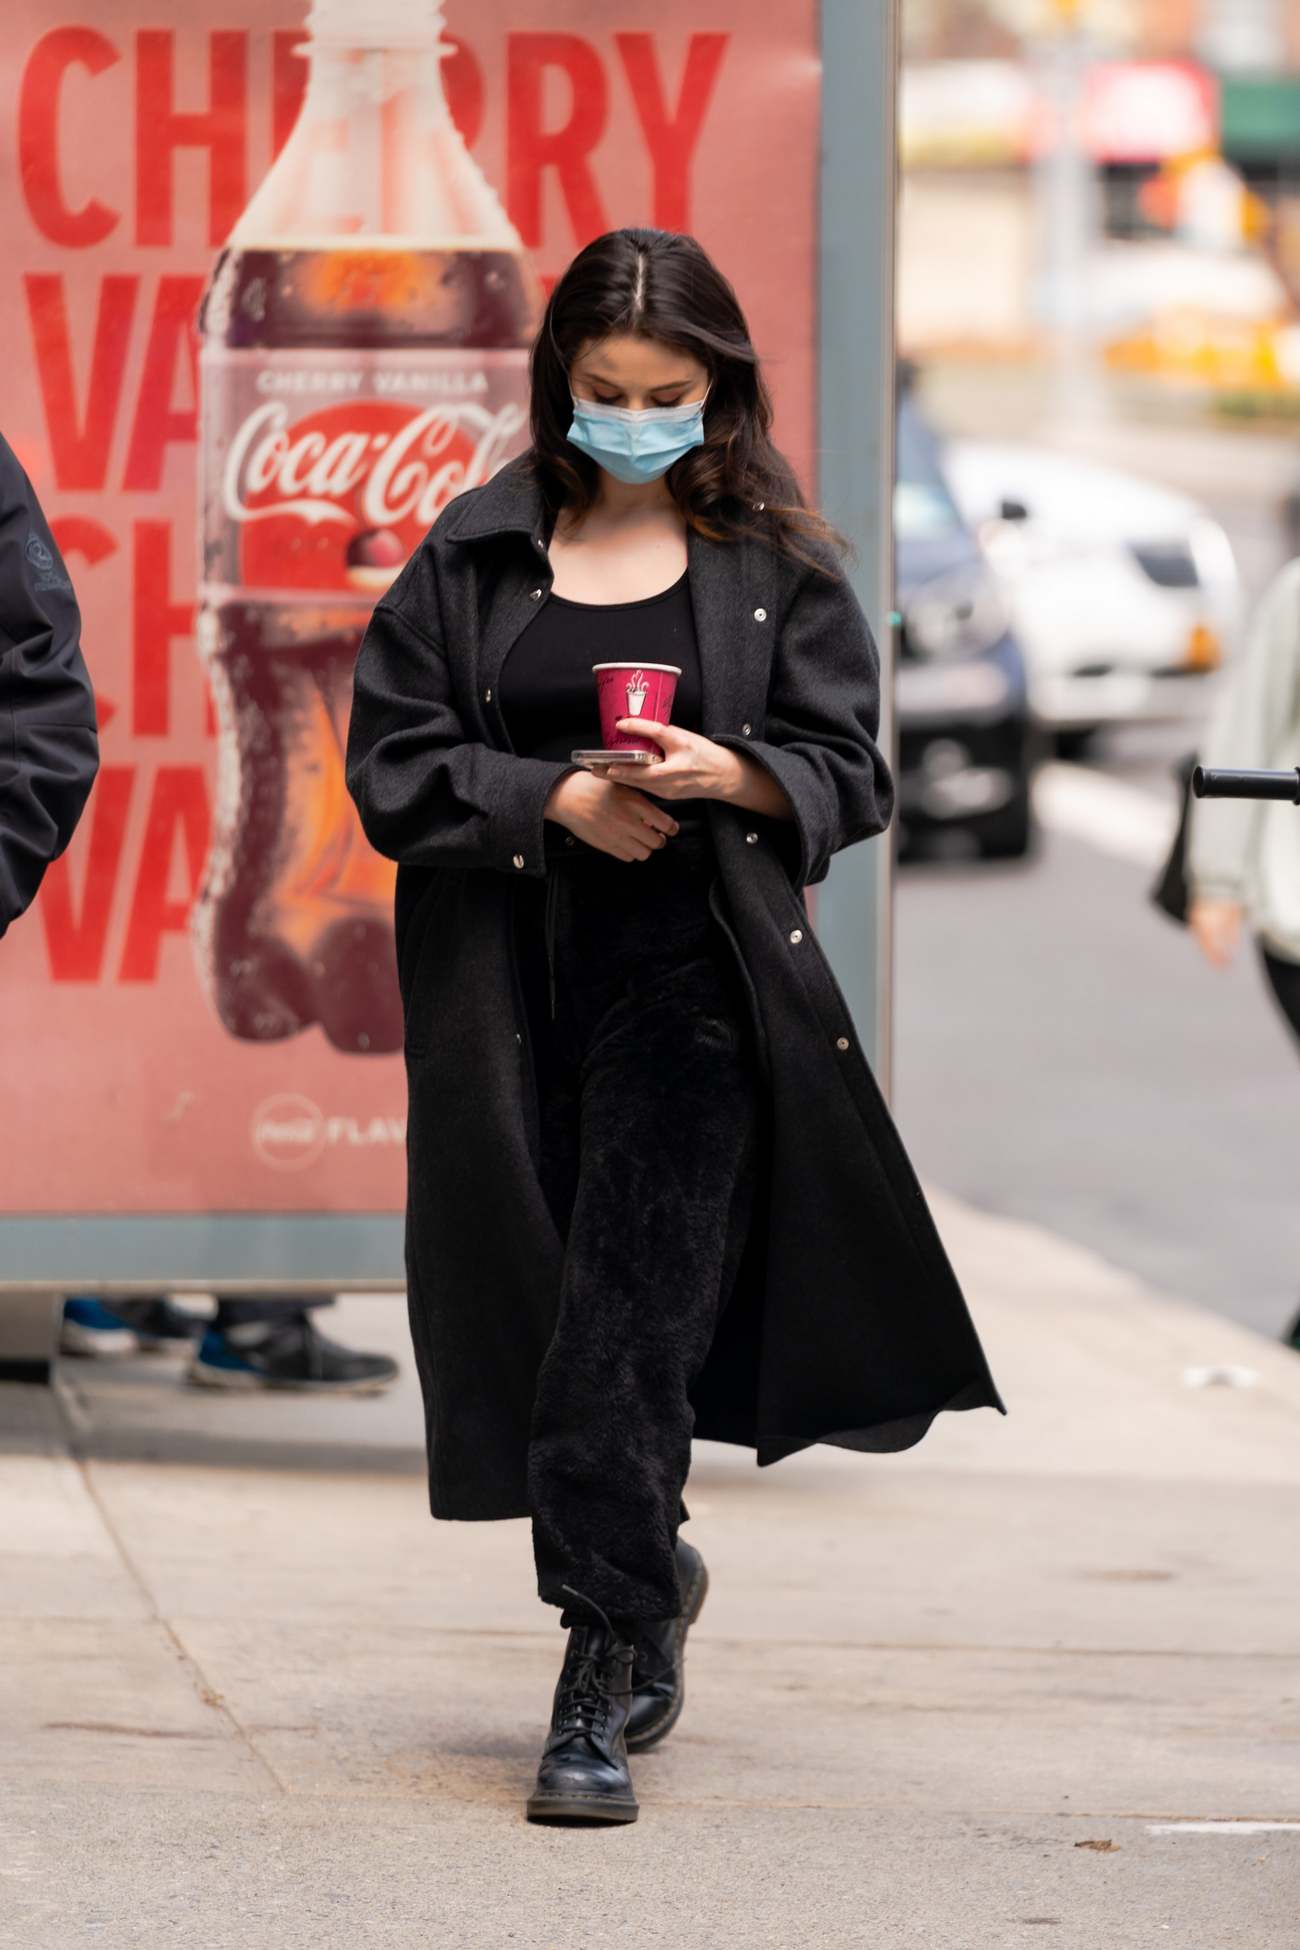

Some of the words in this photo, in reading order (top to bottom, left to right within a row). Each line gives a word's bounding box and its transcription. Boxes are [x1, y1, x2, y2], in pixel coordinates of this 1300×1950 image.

[257, 370, 365, 394] CHERRY
[373, 370, 489, 394] VANILLA
[224, 402, 527, 526] Coca-Col
